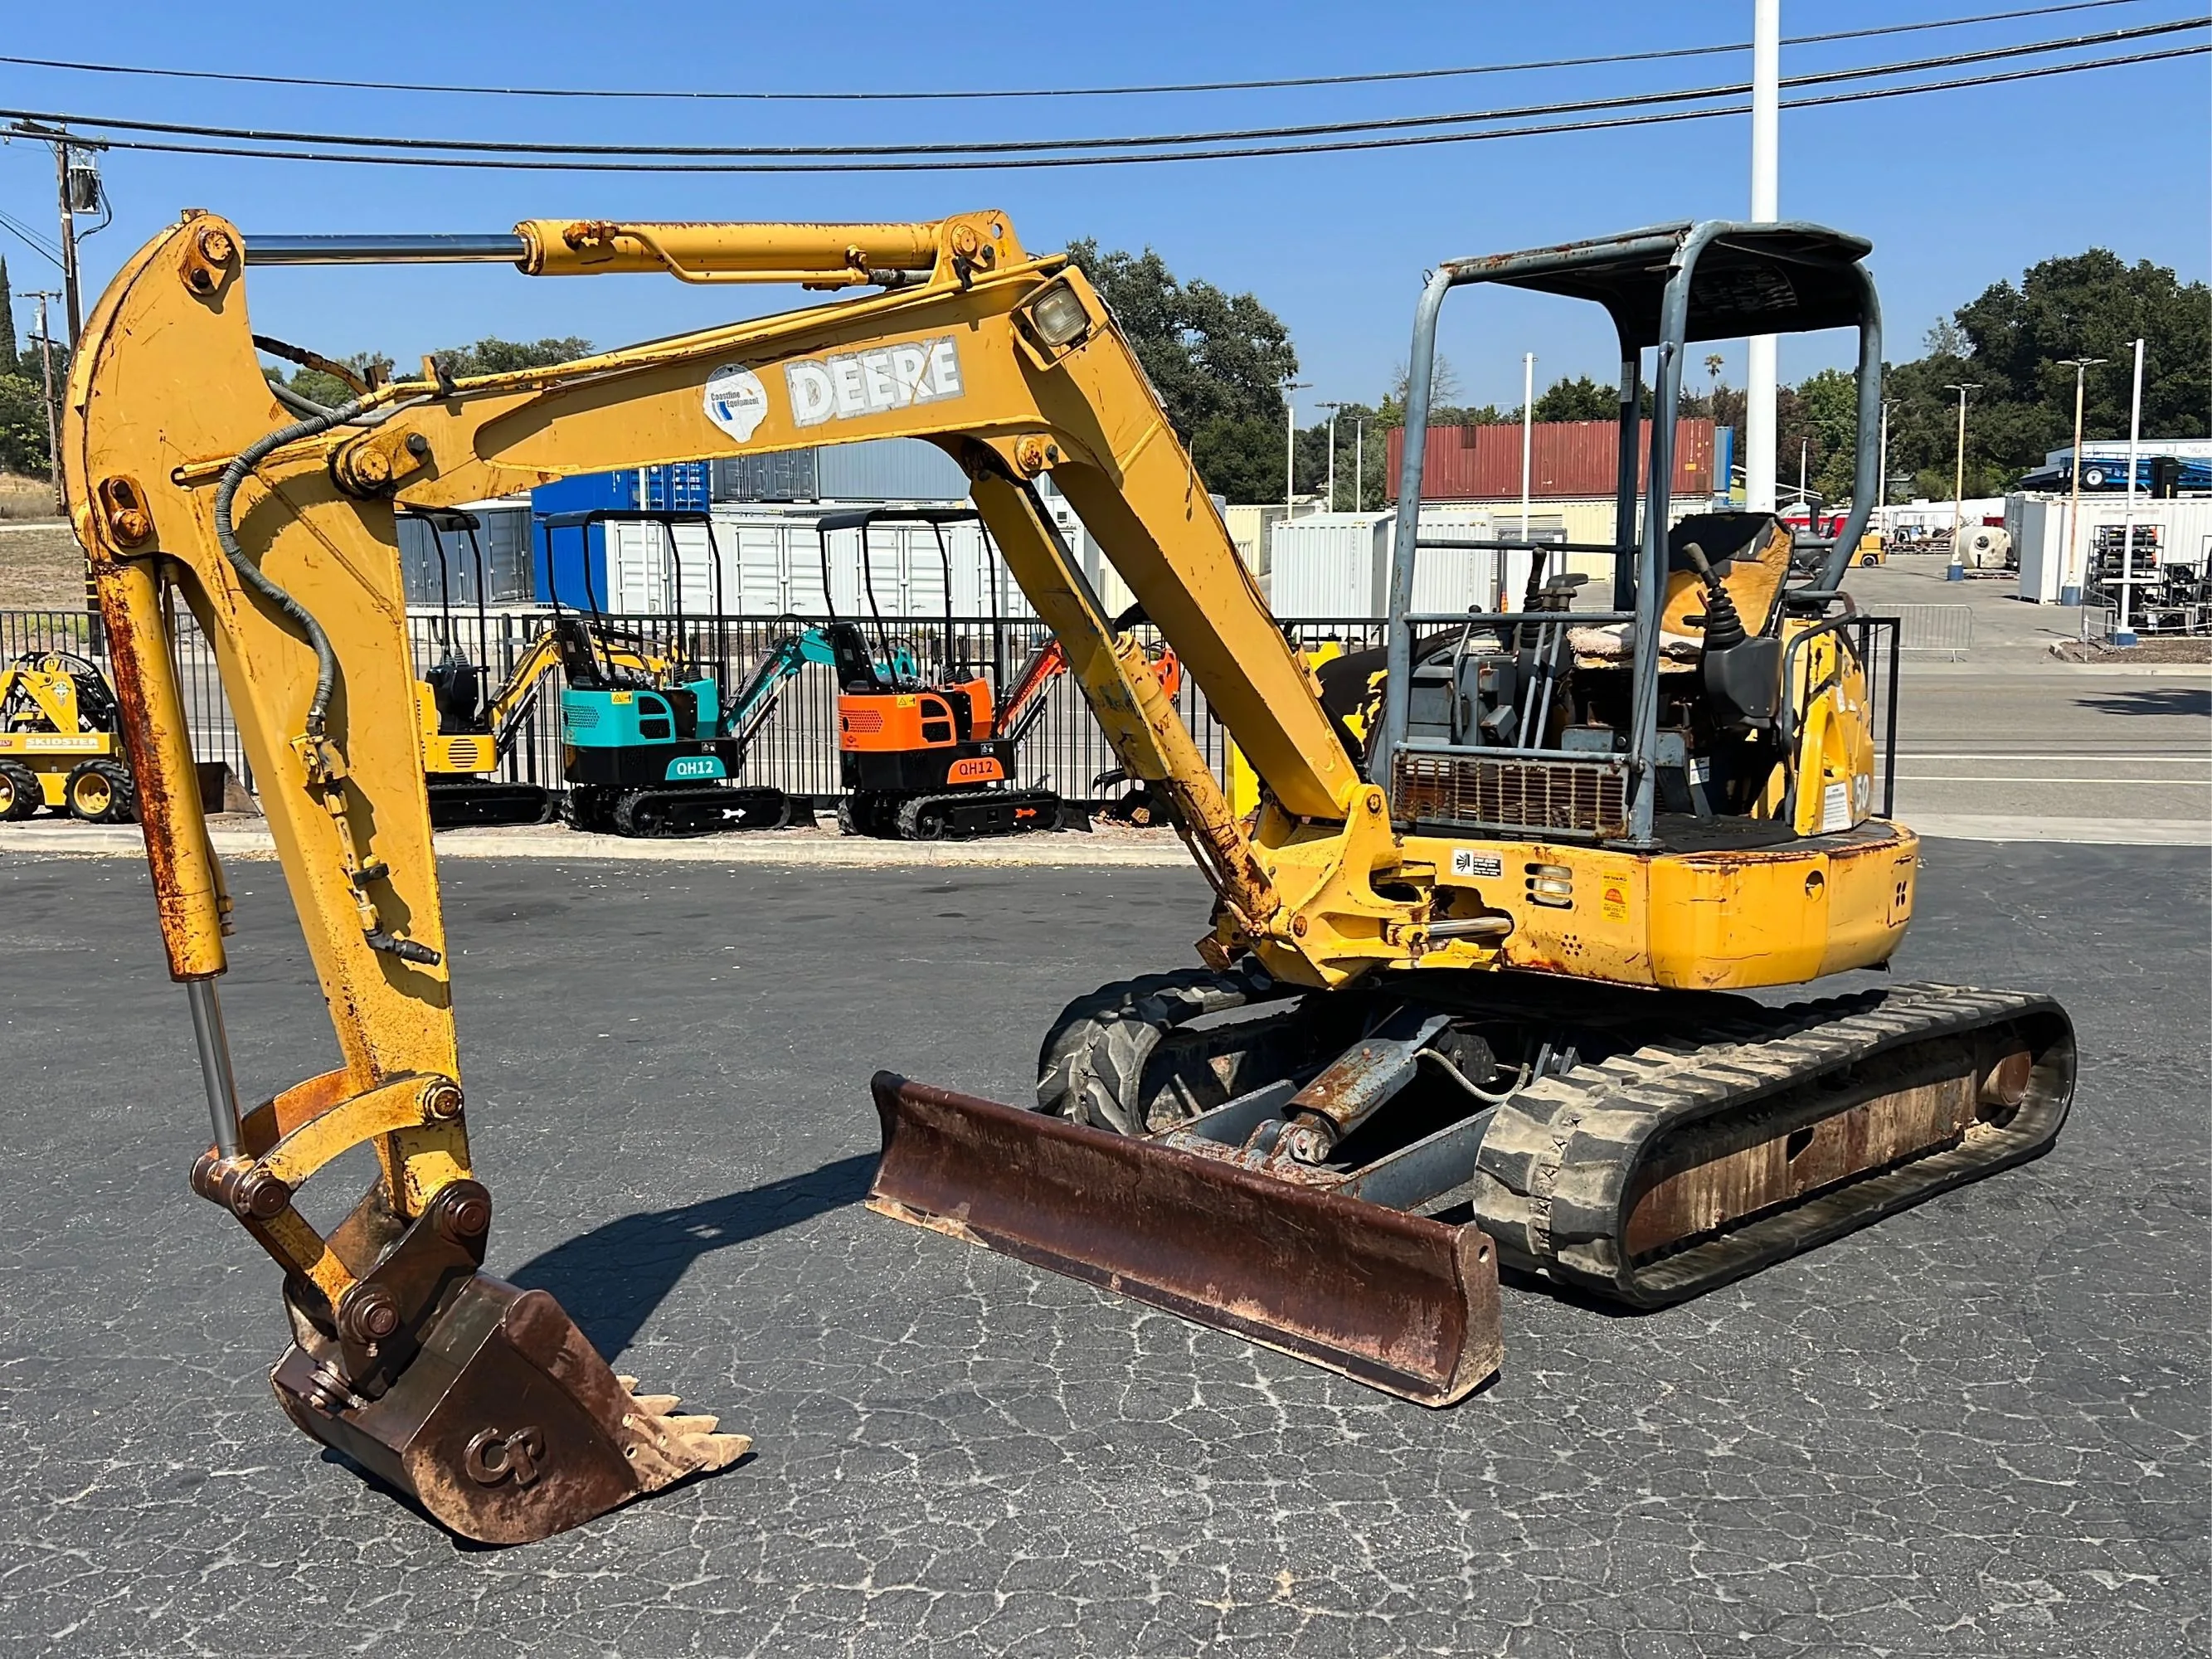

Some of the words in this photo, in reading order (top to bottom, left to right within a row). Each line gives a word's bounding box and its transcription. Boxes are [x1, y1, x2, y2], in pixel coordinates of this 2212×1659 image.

[789, 341, 960, 421] DEERE
[711, 392, 741, 401] Coastline
[727, 397, 760, 408] Equipment
[27, 737, 98, 746] SKIDSTER
[676, 761, 714, 776] QH12
[959, 761, 993, 775] QH12
